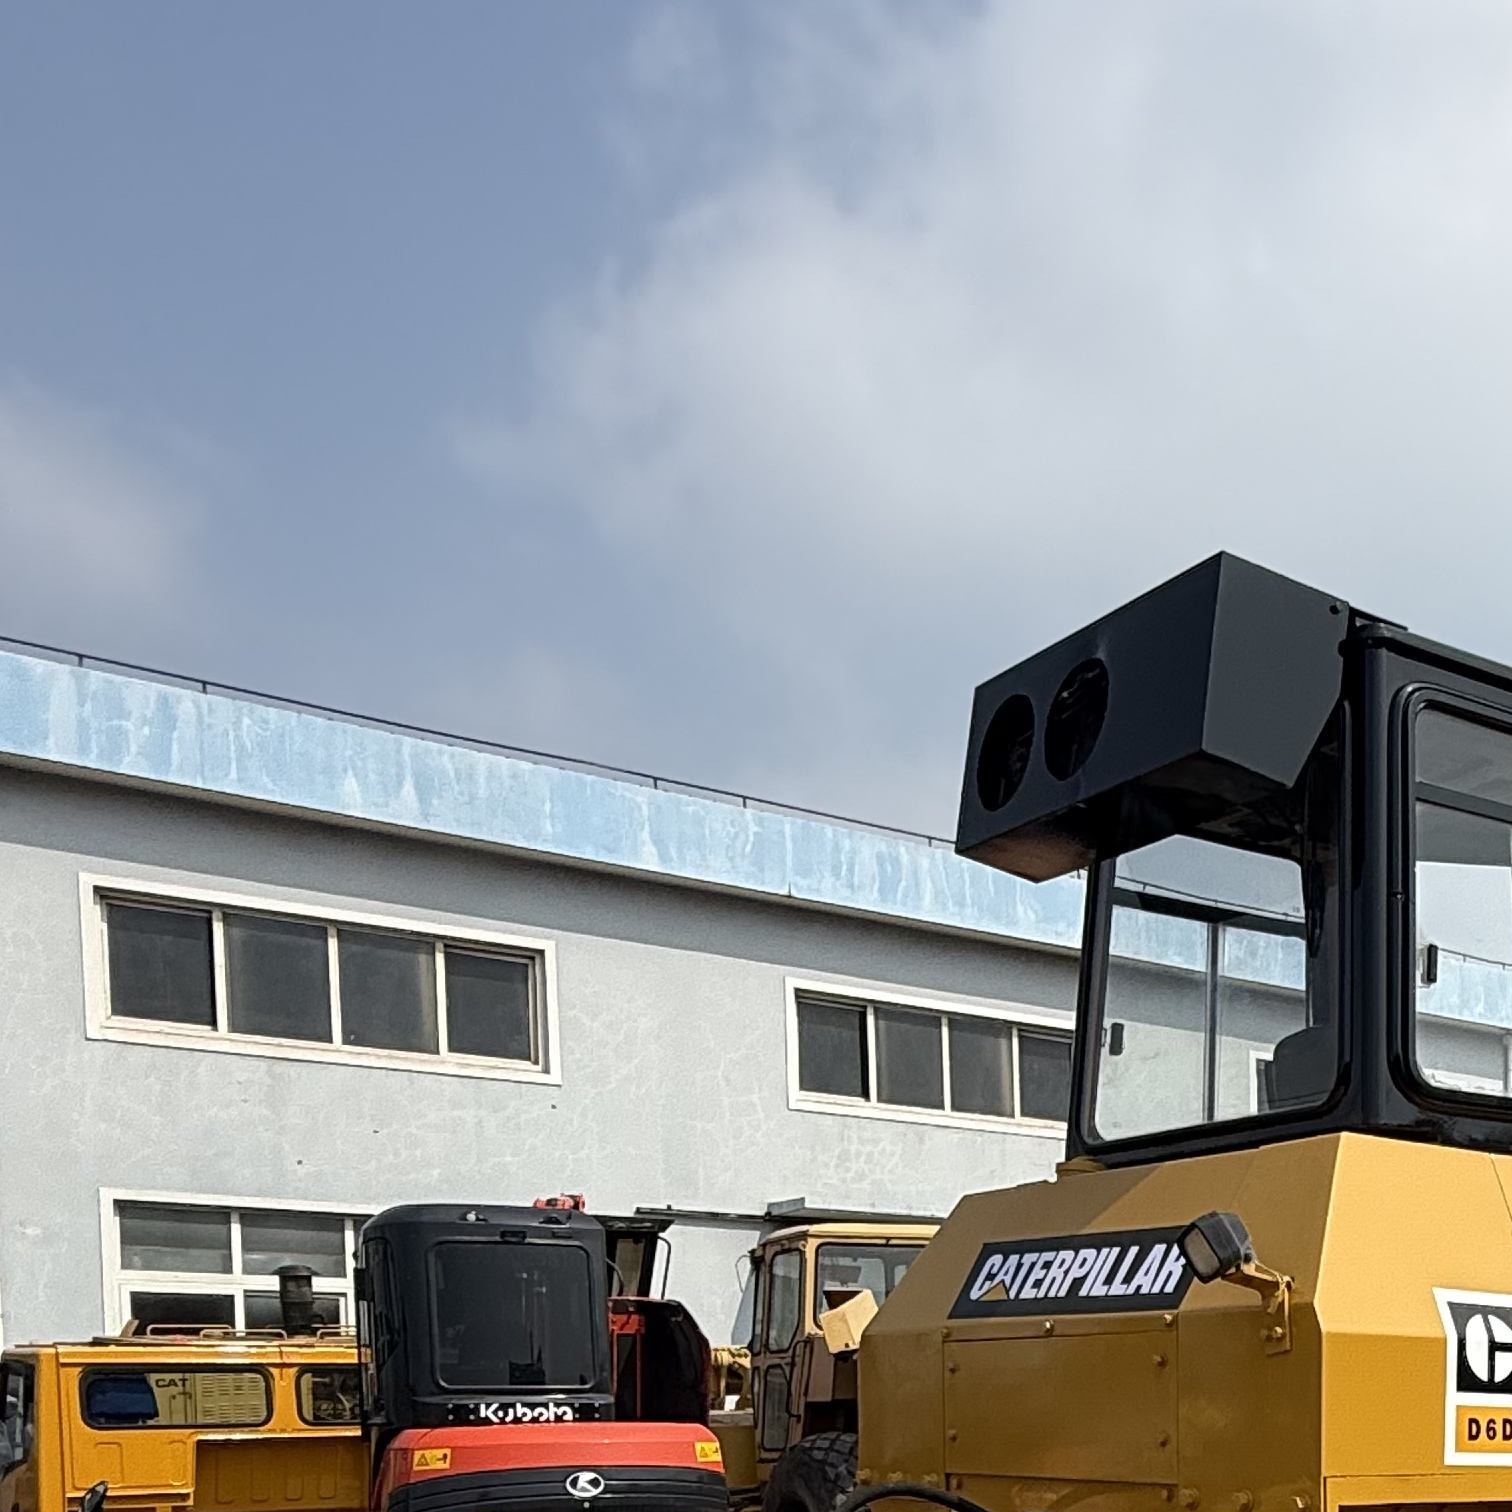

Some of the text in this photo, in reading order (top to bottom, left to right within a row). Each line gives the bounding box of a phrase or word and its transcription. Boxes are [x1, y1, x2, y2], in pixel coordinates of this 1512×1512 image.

[970, 1243, 1187, 1300] CATERPILLAR
[154, 1377, 189, 1389] CAT
[479, 1402, 574, 1423] Kubota
